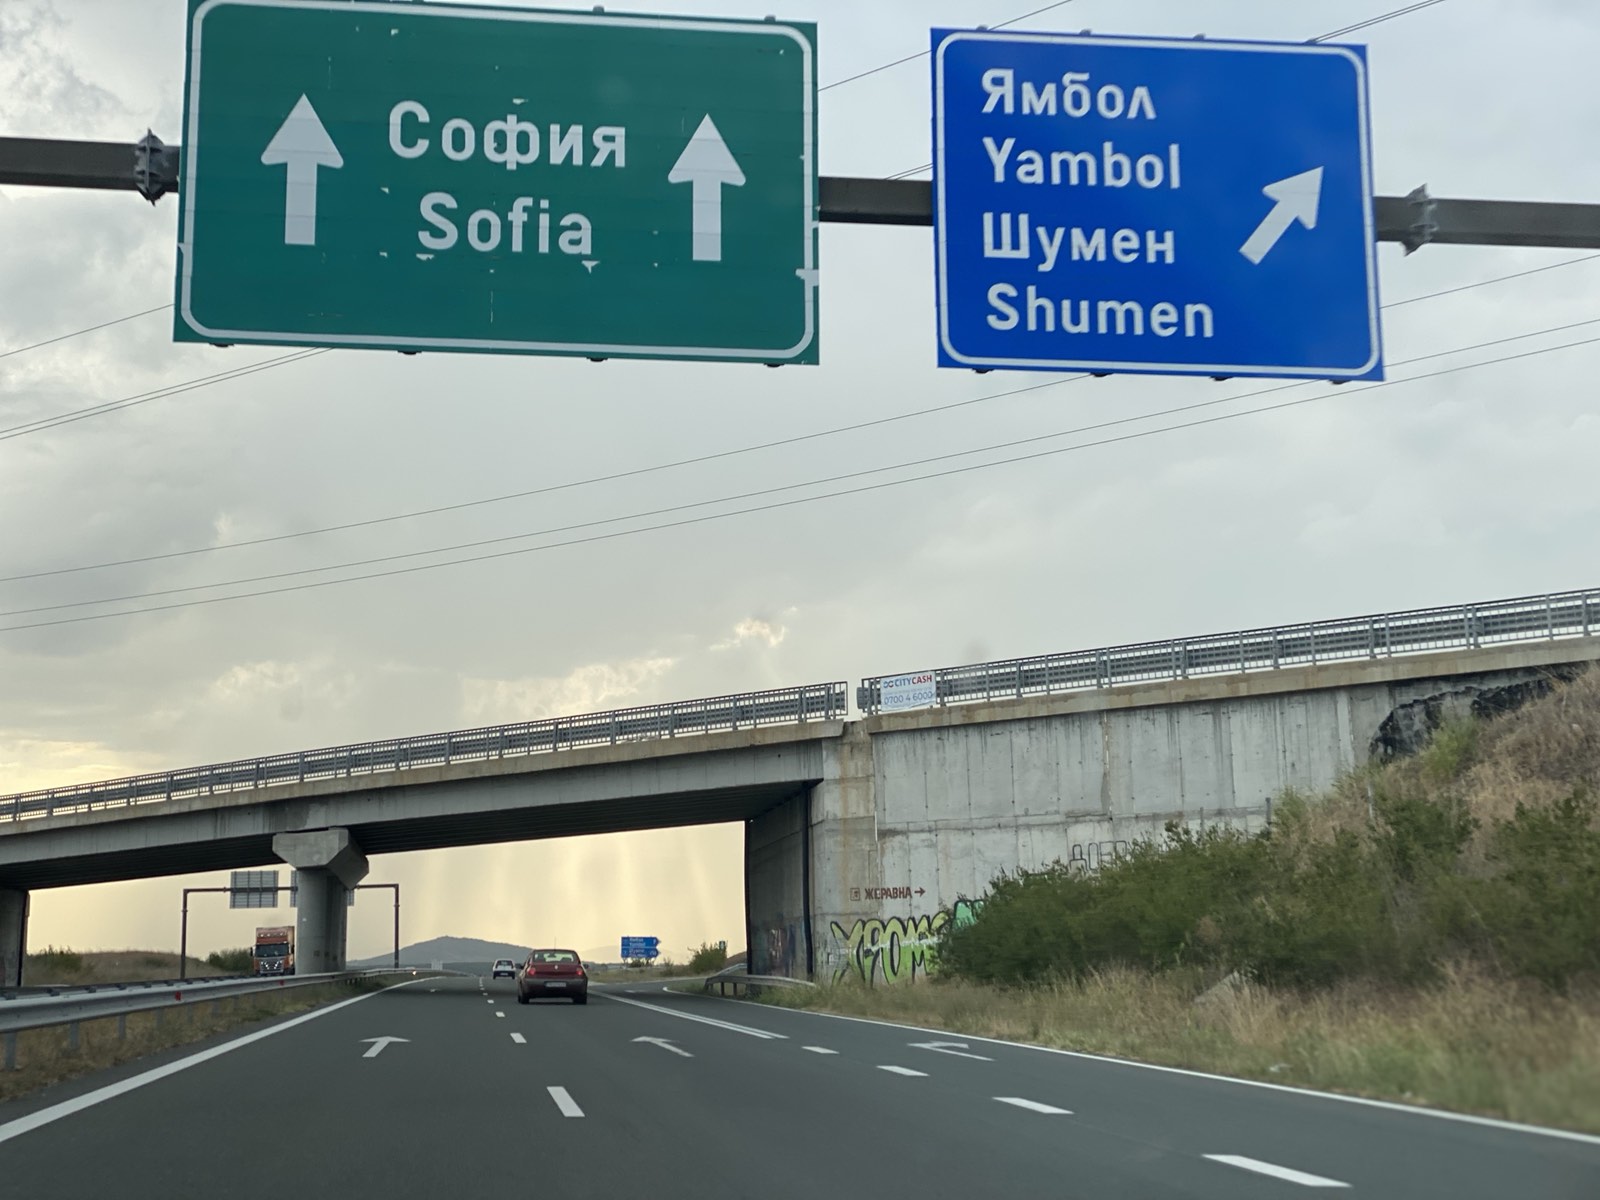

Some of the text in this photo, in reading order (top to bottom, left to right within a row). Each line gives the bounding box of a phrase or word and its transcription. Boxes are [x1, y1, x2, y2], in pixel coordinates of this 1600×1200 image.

[981, 68, 1157, 119] Ямбол
[389, 100, 626, 170] София
[982, 137, 1181, 189] Yambol
[417, 192, 593, 256] Sofia
[983, 212, 1175, 272] Шумен
[986, 283, 1213, 338] Shumen
[884, 694, 904, 705] 0700
[906, 694, 911, 702] 4
[912, 690, 933, 701] 6000
[864, 886, 912, 900] ЖЕРАВНА
